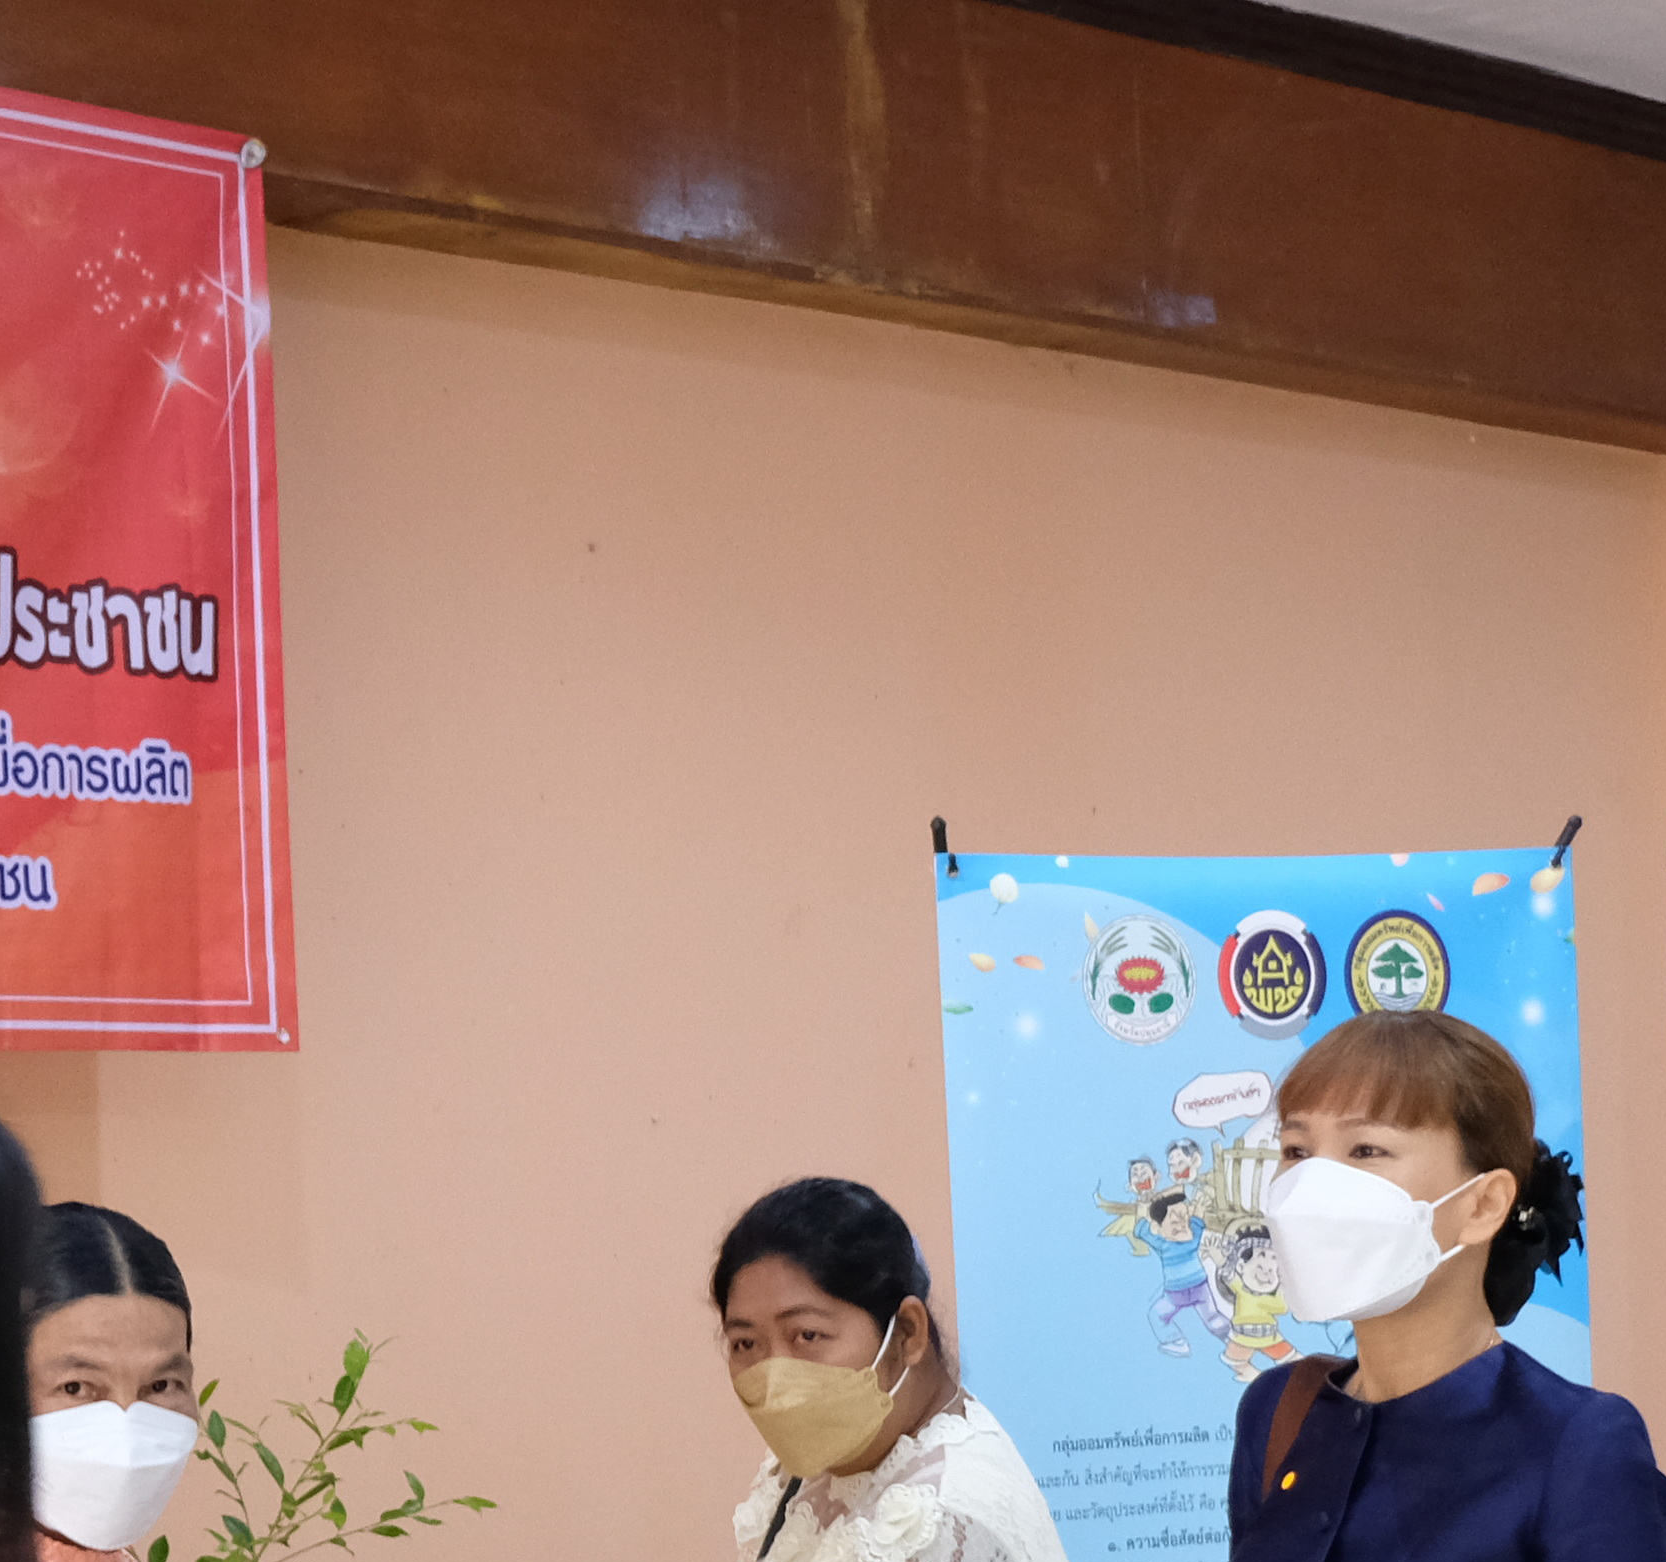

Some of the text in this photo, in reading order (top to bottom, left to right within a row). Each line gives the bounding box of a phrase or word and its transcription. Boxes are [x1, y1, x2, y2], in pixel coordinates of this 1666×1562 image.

[1052, 1425, 1210, 1457] กลุ่มออมทรัพย์เพื่อการผลิต
